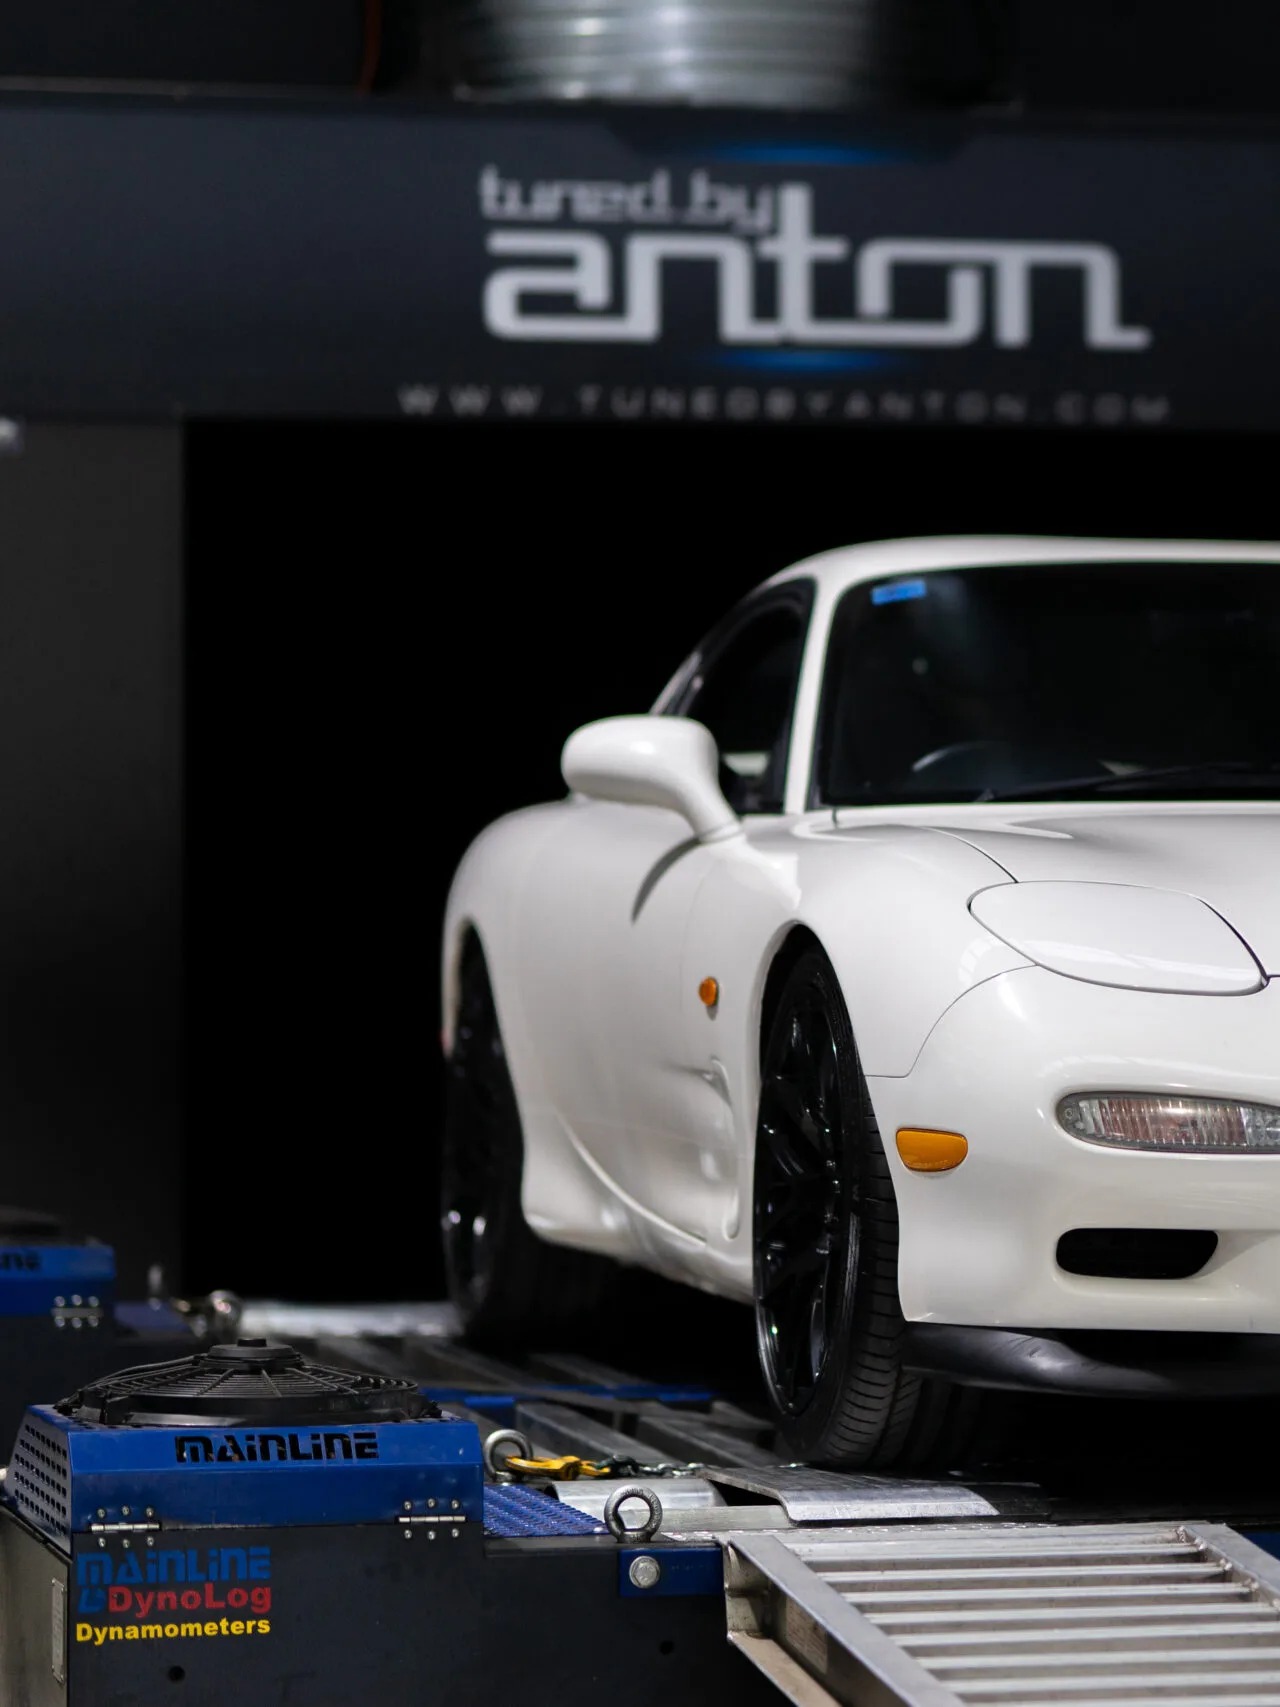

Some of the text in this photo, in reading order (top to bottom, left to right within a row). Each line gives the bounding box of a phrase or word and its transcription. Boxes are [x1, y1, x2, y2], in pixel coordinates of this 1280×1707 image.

[483, 183, 1152, 349] anton
[108, 1582, 272, 1619] DynoLog
[75, 1616, 271, 1646] Dynamometers
